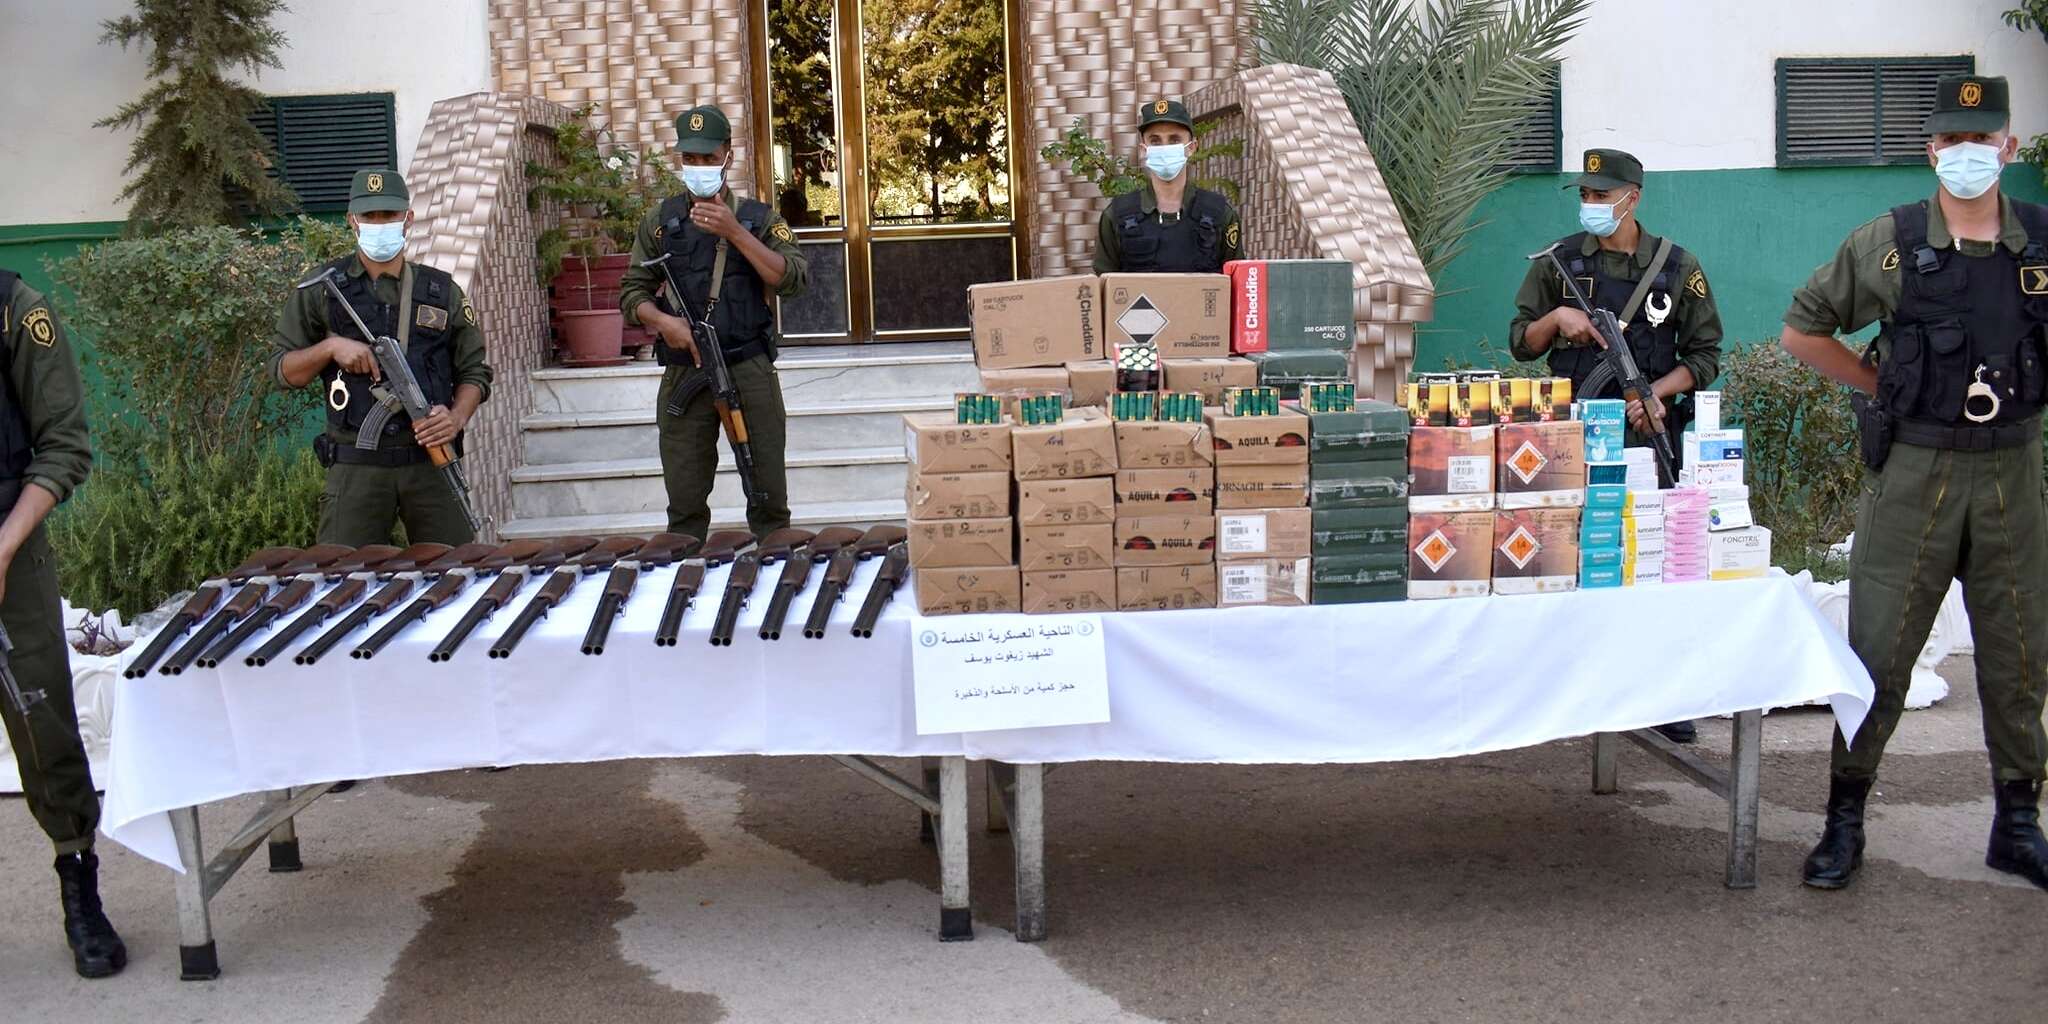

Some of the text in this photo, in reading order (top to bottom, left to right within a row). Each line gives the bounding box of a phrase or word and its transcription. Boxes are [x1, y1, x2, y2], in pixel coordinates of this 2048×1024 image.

[1246, 267, 1258, 328] Cheddite
[1080, 300, 1094, 355] Cheddite
[1239, 437, 1270, 446] AQUILA
[1218, 483, 1264, 491] ORNAGHI
[1128, 491, 1160, 501] AQUILA
[1161, 538, 1193, 547] AQUILA
[1722, 535, 1759, 543] FONCITRIL
[941, 624, 1074, 645] الناحية العسكرية الخامسة
[1027, 647, 1054, 660] الشهيد
[964, 653, 992, 665] يوسف
[1024, 686, 1035, 695] من
[1037, 681, 1055, 693] كمية
[1058, 682, 1075, 692] حجز
